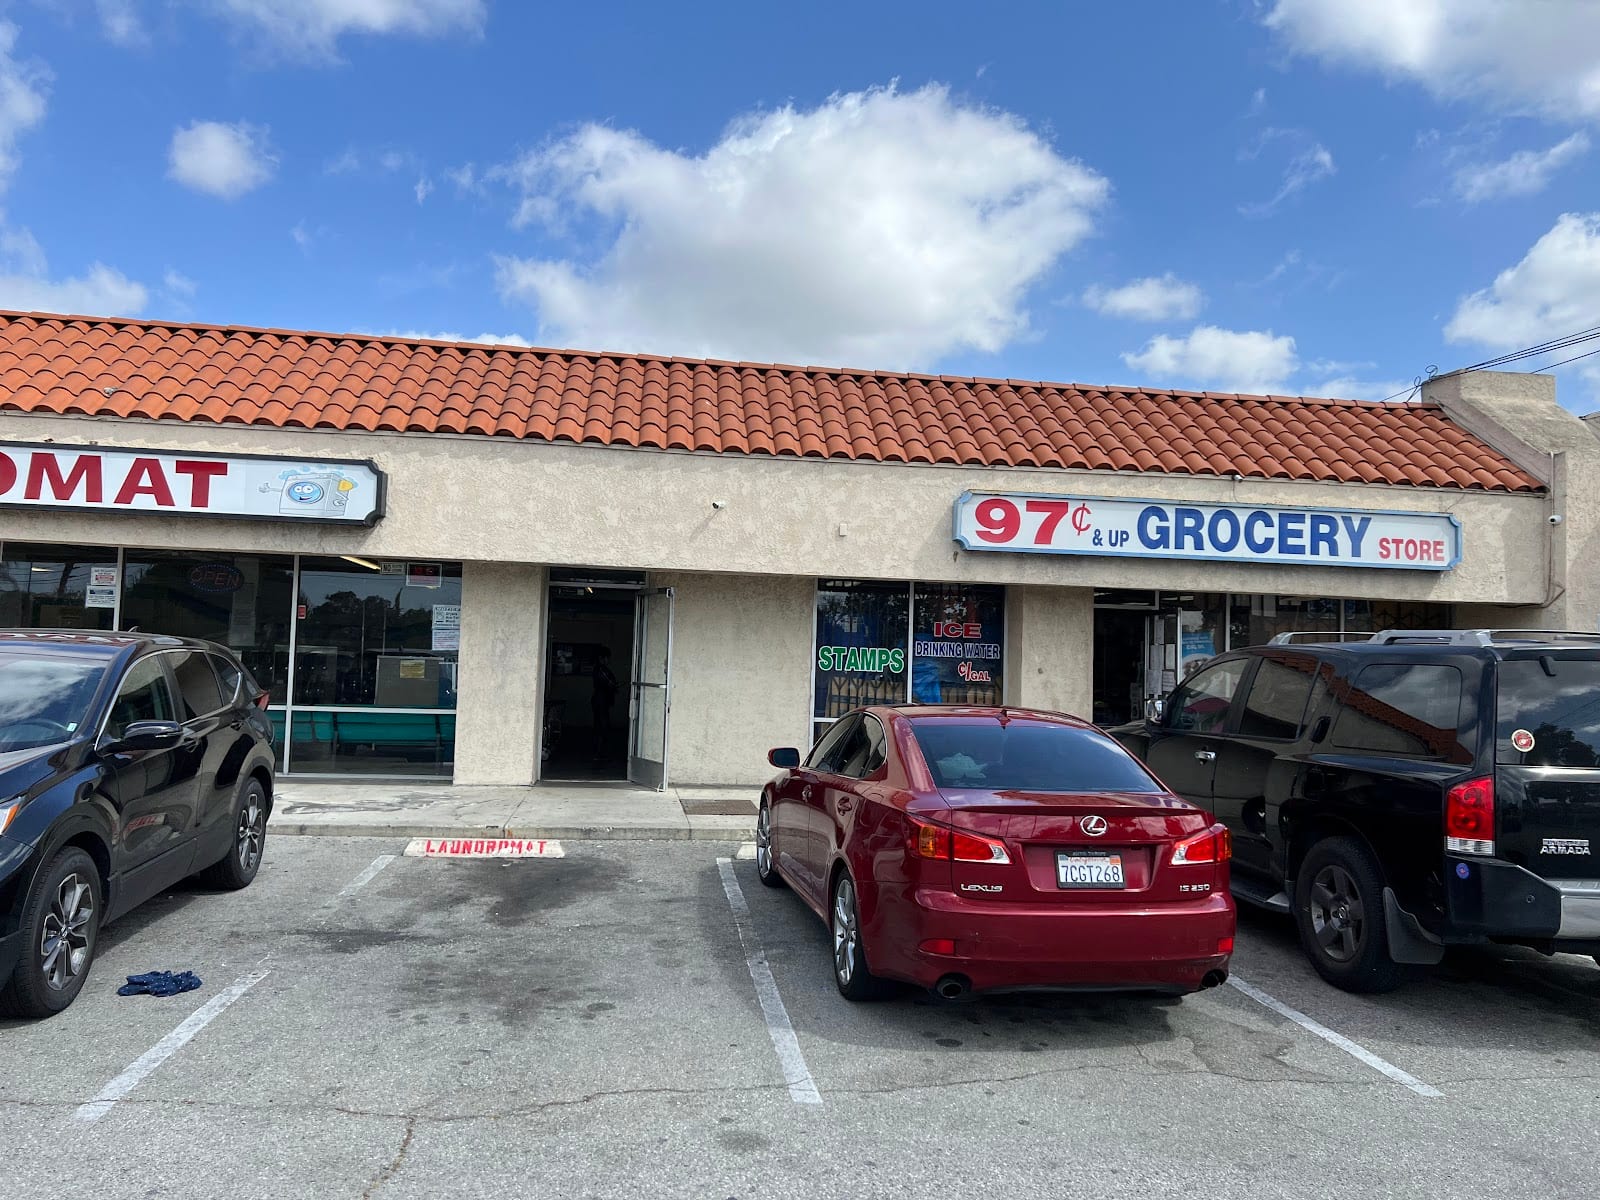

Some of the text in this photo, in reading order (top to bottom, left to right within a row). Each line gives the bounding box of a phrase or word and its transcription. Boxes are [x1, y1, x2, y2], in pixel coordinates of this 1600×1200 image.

[1092, 528, 1103, 546] &
[1108, 529, 1129, 547] UP
[1137, 505, 1372, 557] GROCERY
[1378, 537, 1445, 562] STORE
[191, 568, 241, 589] OPEN
[934, 621, 982, 639] ICE
[818, 645, 905, 674] STAMPS
[915, 641, 1000, 660] DRINKING WATER
[1540, 846, 1591, 855] ARMADA
[1060, 865, 1120, 882] 7CGT268
[960, 883, 1003, 892] LEXUS
[1191, 883, 1211, 891] 250
